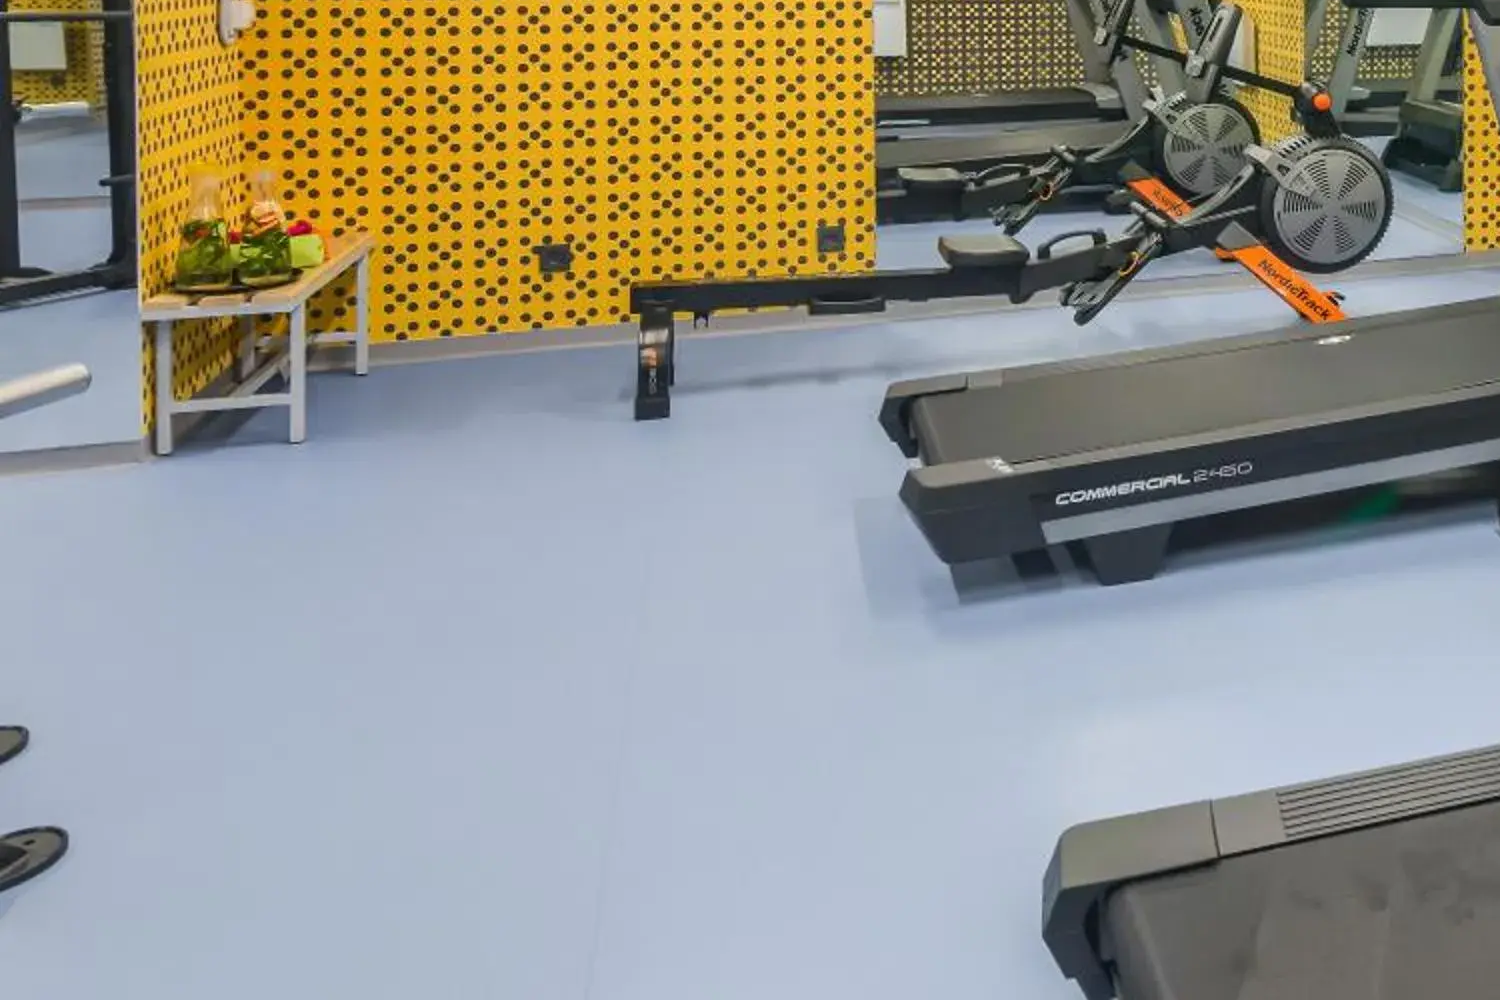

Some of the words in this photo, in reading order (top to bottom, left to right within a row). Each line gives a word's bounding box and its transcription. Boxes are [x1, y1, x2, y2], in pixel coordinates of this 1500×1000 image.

[1258, 259, 1331, 321] NordicTrack
[1055, 473, 1191, 505] COMMERCIAL
[1193, 461, 1253, 483] 2450
